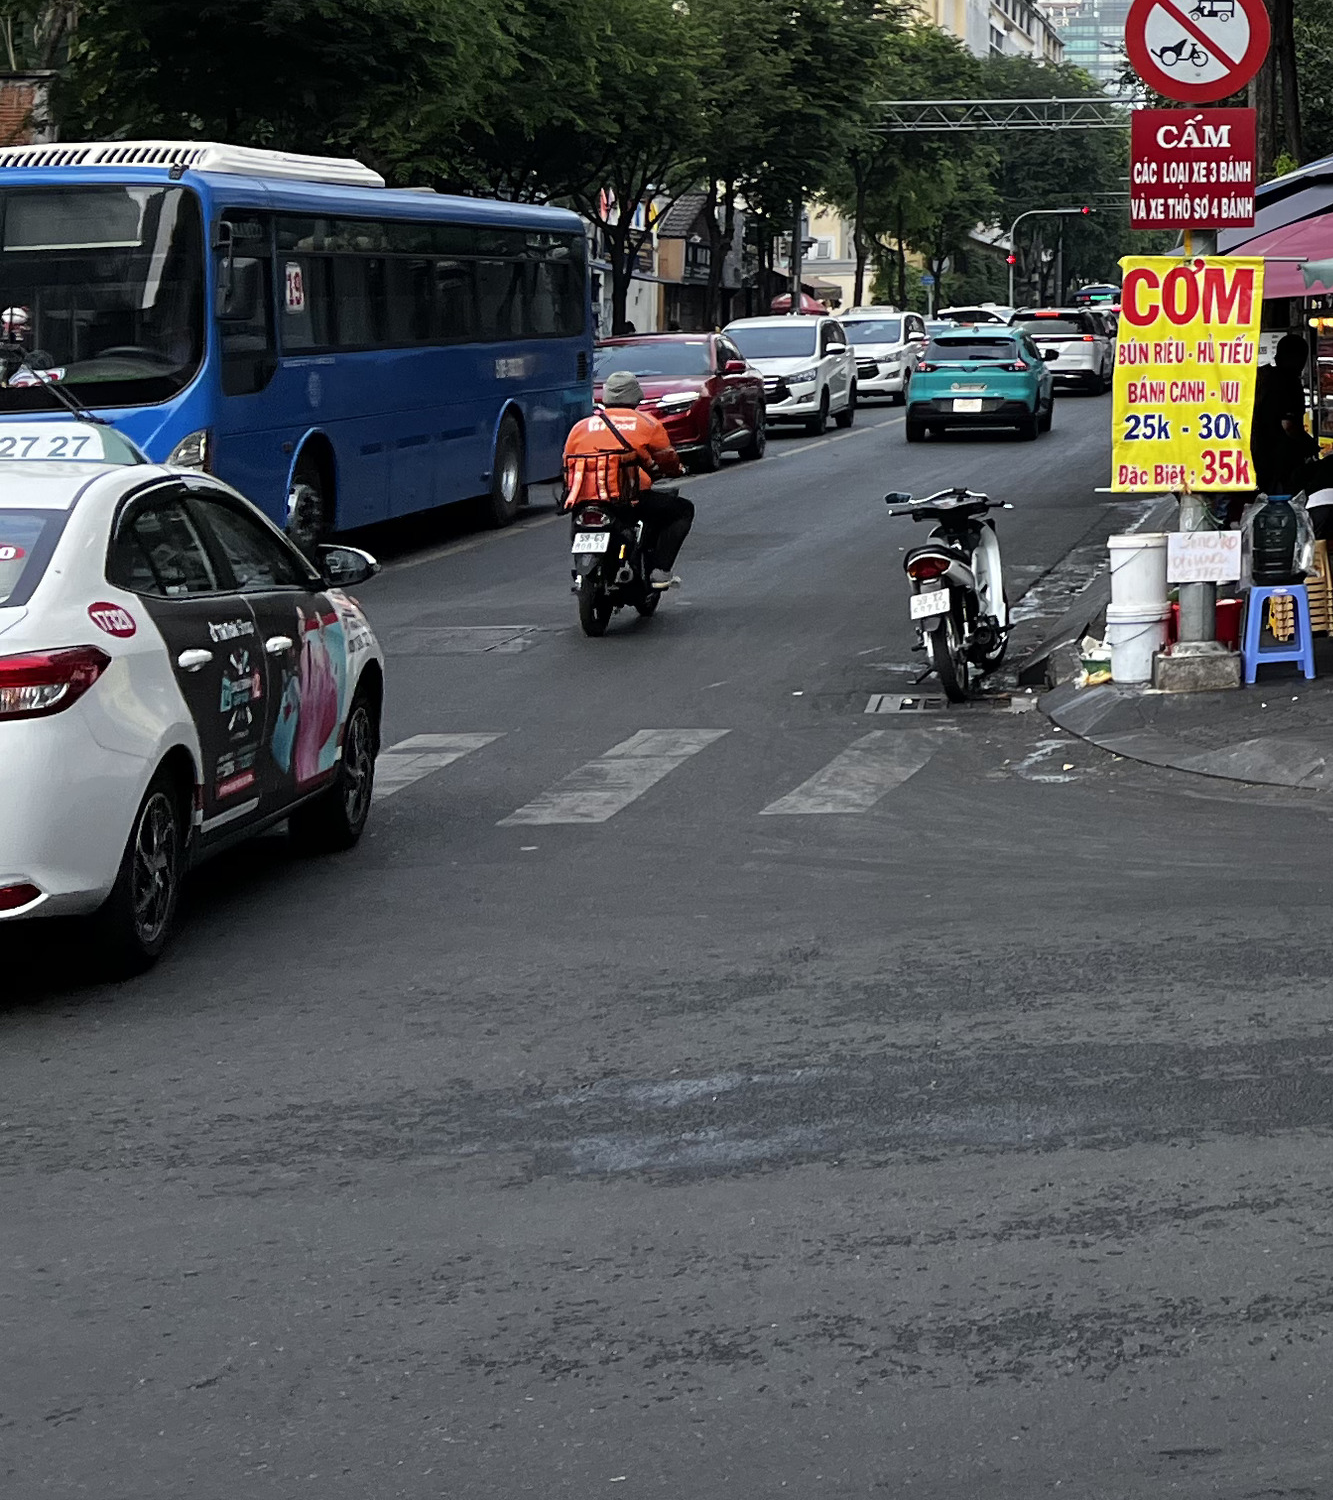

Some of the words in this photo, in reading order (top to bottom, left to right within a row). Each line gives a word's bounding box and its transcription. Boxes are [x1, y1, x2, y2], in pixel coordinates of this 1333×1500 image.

[1156, 114, 1231, 149] CẤM
[1133, 156, 1158, 184] CÁC
[1163, 161, 1189, 190] LOẠI
[1191, 161, 1207, 183] XE
[1209, 161, 1217, 184] 3
[1219, 155, 1252, 183] BÁNH
[1131, 192, 1147, 220] VÀ
[1149, 198, 1165, 220] XE
[1167, 192, 1191, 220] THÔ
[1193, 193, 1210, 220] SƠ
[1211, 198, 1219, 219] 4
[1221, 191, 1253, 219] BÁNH
[1120, 258, 1255, 327] CƠM
[1119, 338, 1149, 365] BÚN
[1154, 336, 1184, 364] RIÊU
[1219, 334, 1254, 364] TIẾU
[1128, 375, 1166, 404] BÁNH
[1170, 381, 1205, 403] CANH
[1124, 414, 1171, 440] 25k
[1198, 413, 1241, 440] 30k
[50, 436, 91, 457] 27
[1201, 450, 1250, 485] 35k
